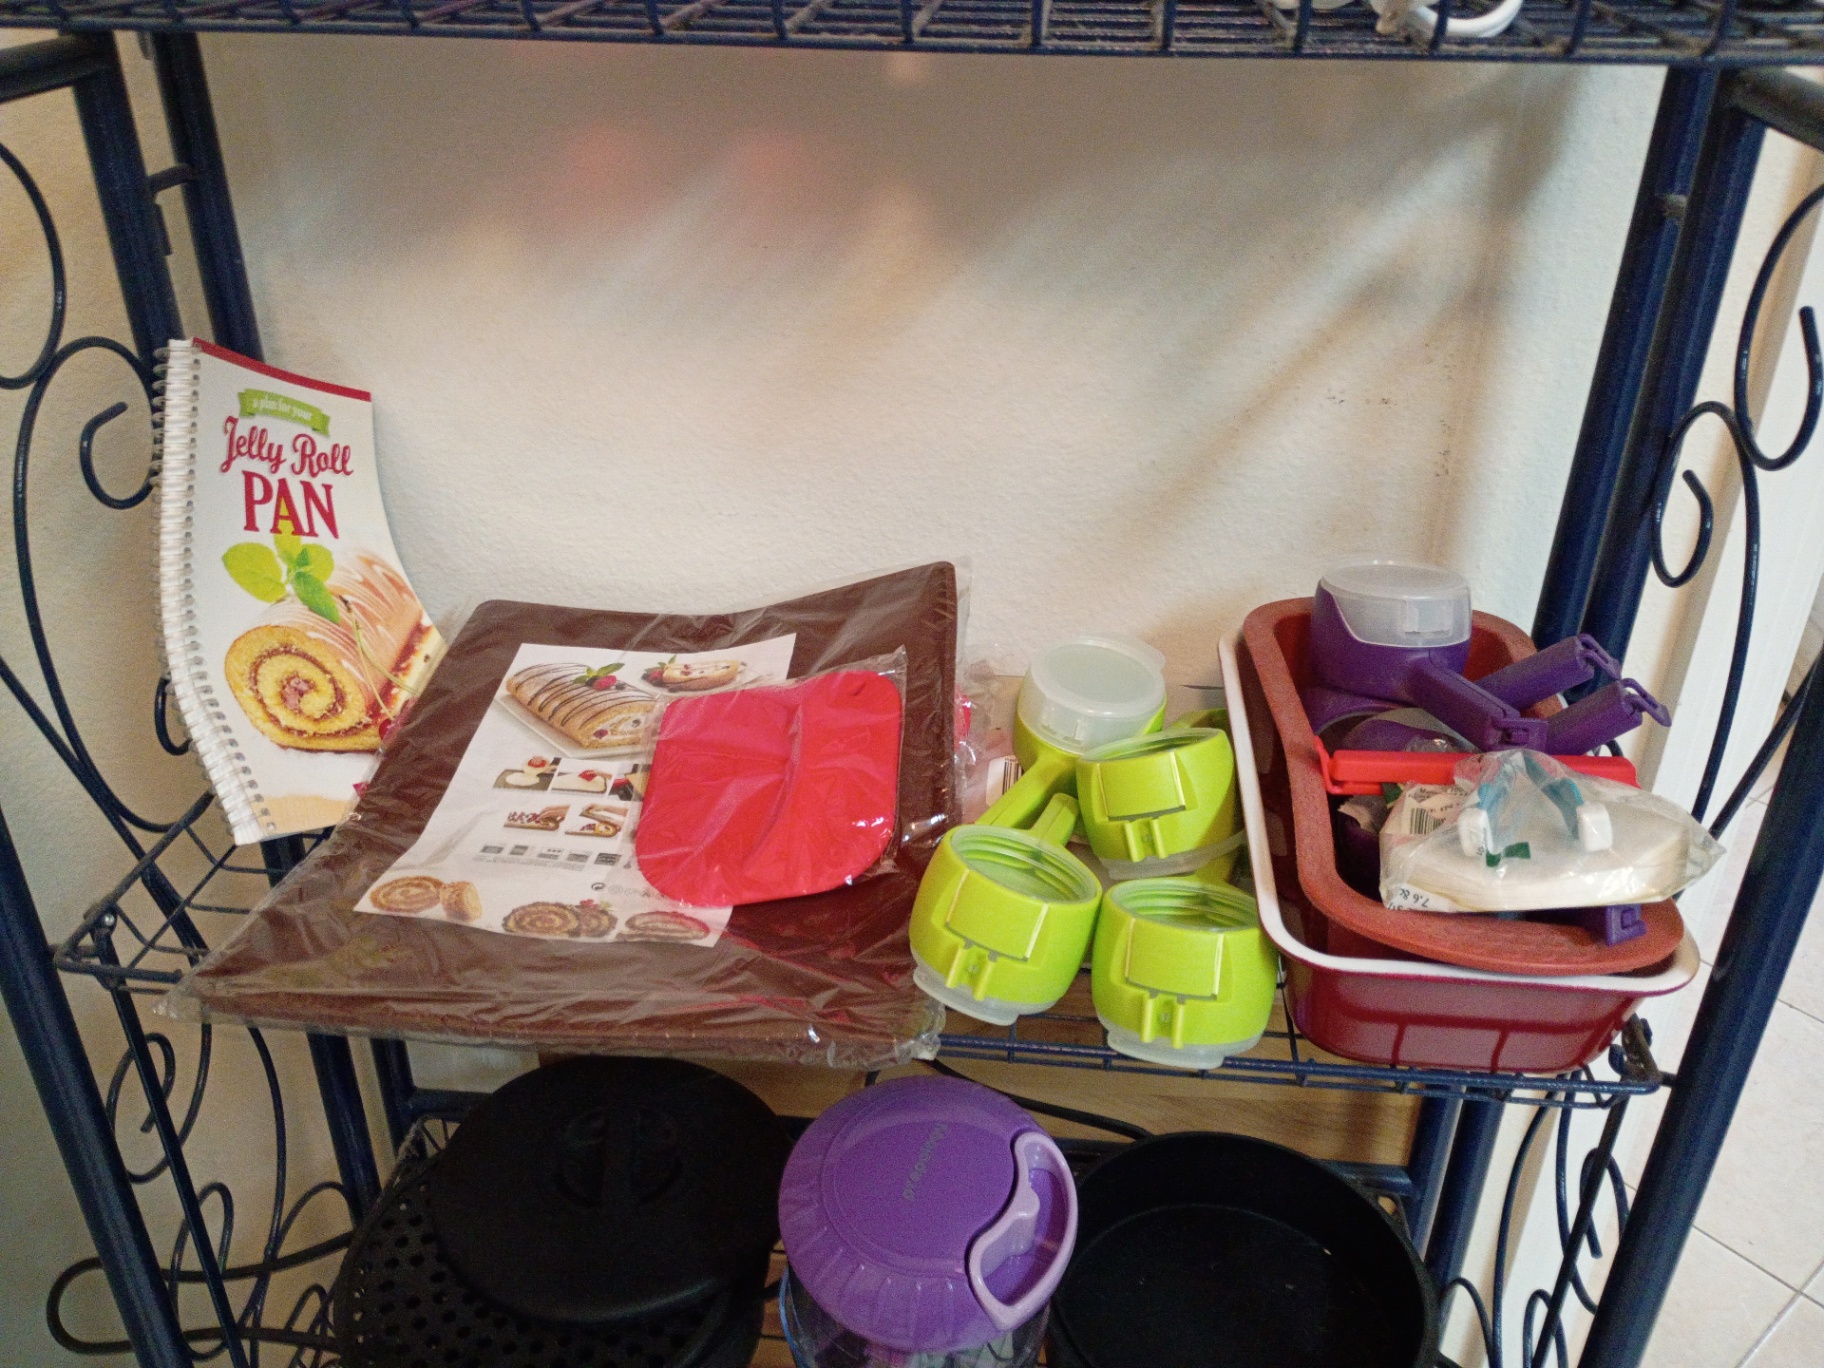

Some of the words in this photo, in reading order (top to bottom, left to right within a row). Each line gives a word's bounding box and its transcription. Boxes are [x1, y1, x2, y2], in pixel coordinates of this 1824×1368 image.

[220, 415, 287, 474] Jelly
[291, 433, 354, 478] Roll
[242, 470, 339, 539] PAN
[1413, 893, 1430, 908] 7.6
